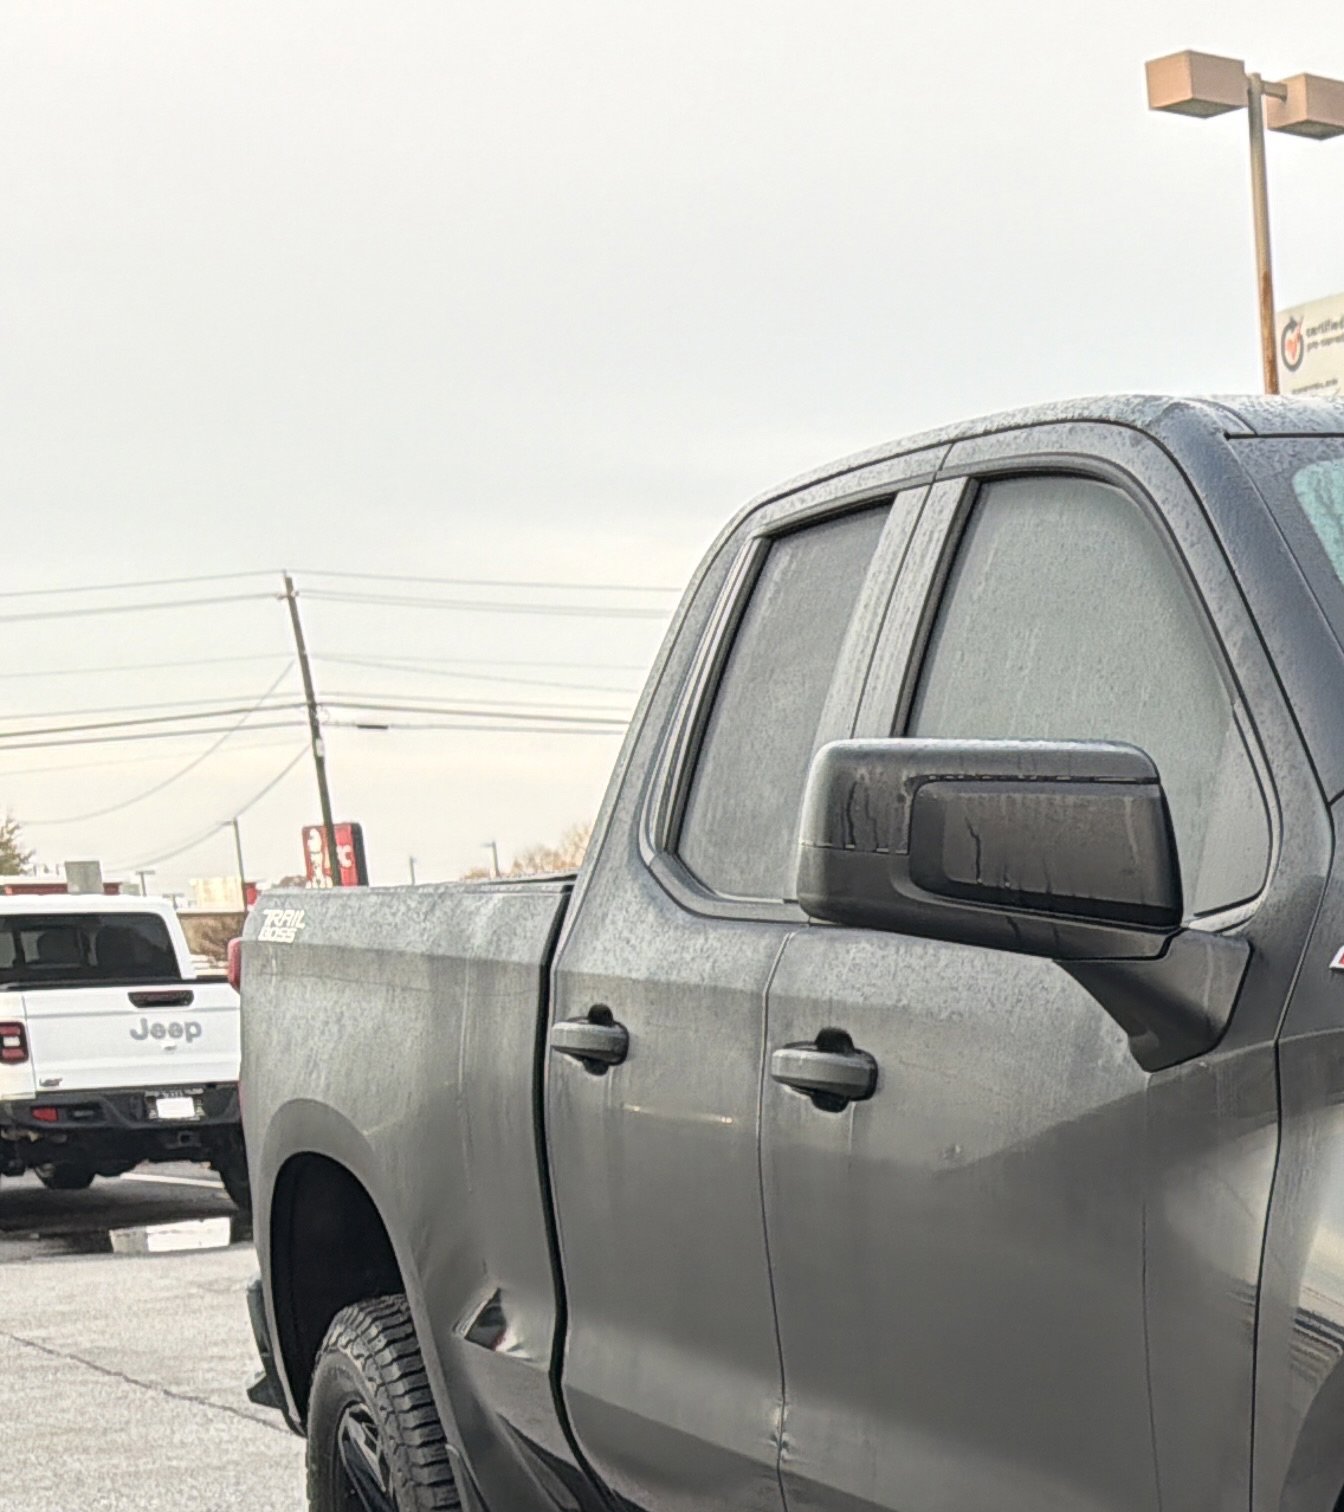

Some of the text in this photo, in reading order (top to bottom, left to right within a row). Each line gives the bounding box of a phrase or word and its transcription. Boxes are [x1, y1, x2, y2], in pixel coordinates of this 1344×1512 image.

[263, 909, 305, 929] TRAIL
[258, 927, 297, 943] BOSS
[130, 1017, 202, 1043] Jeep
